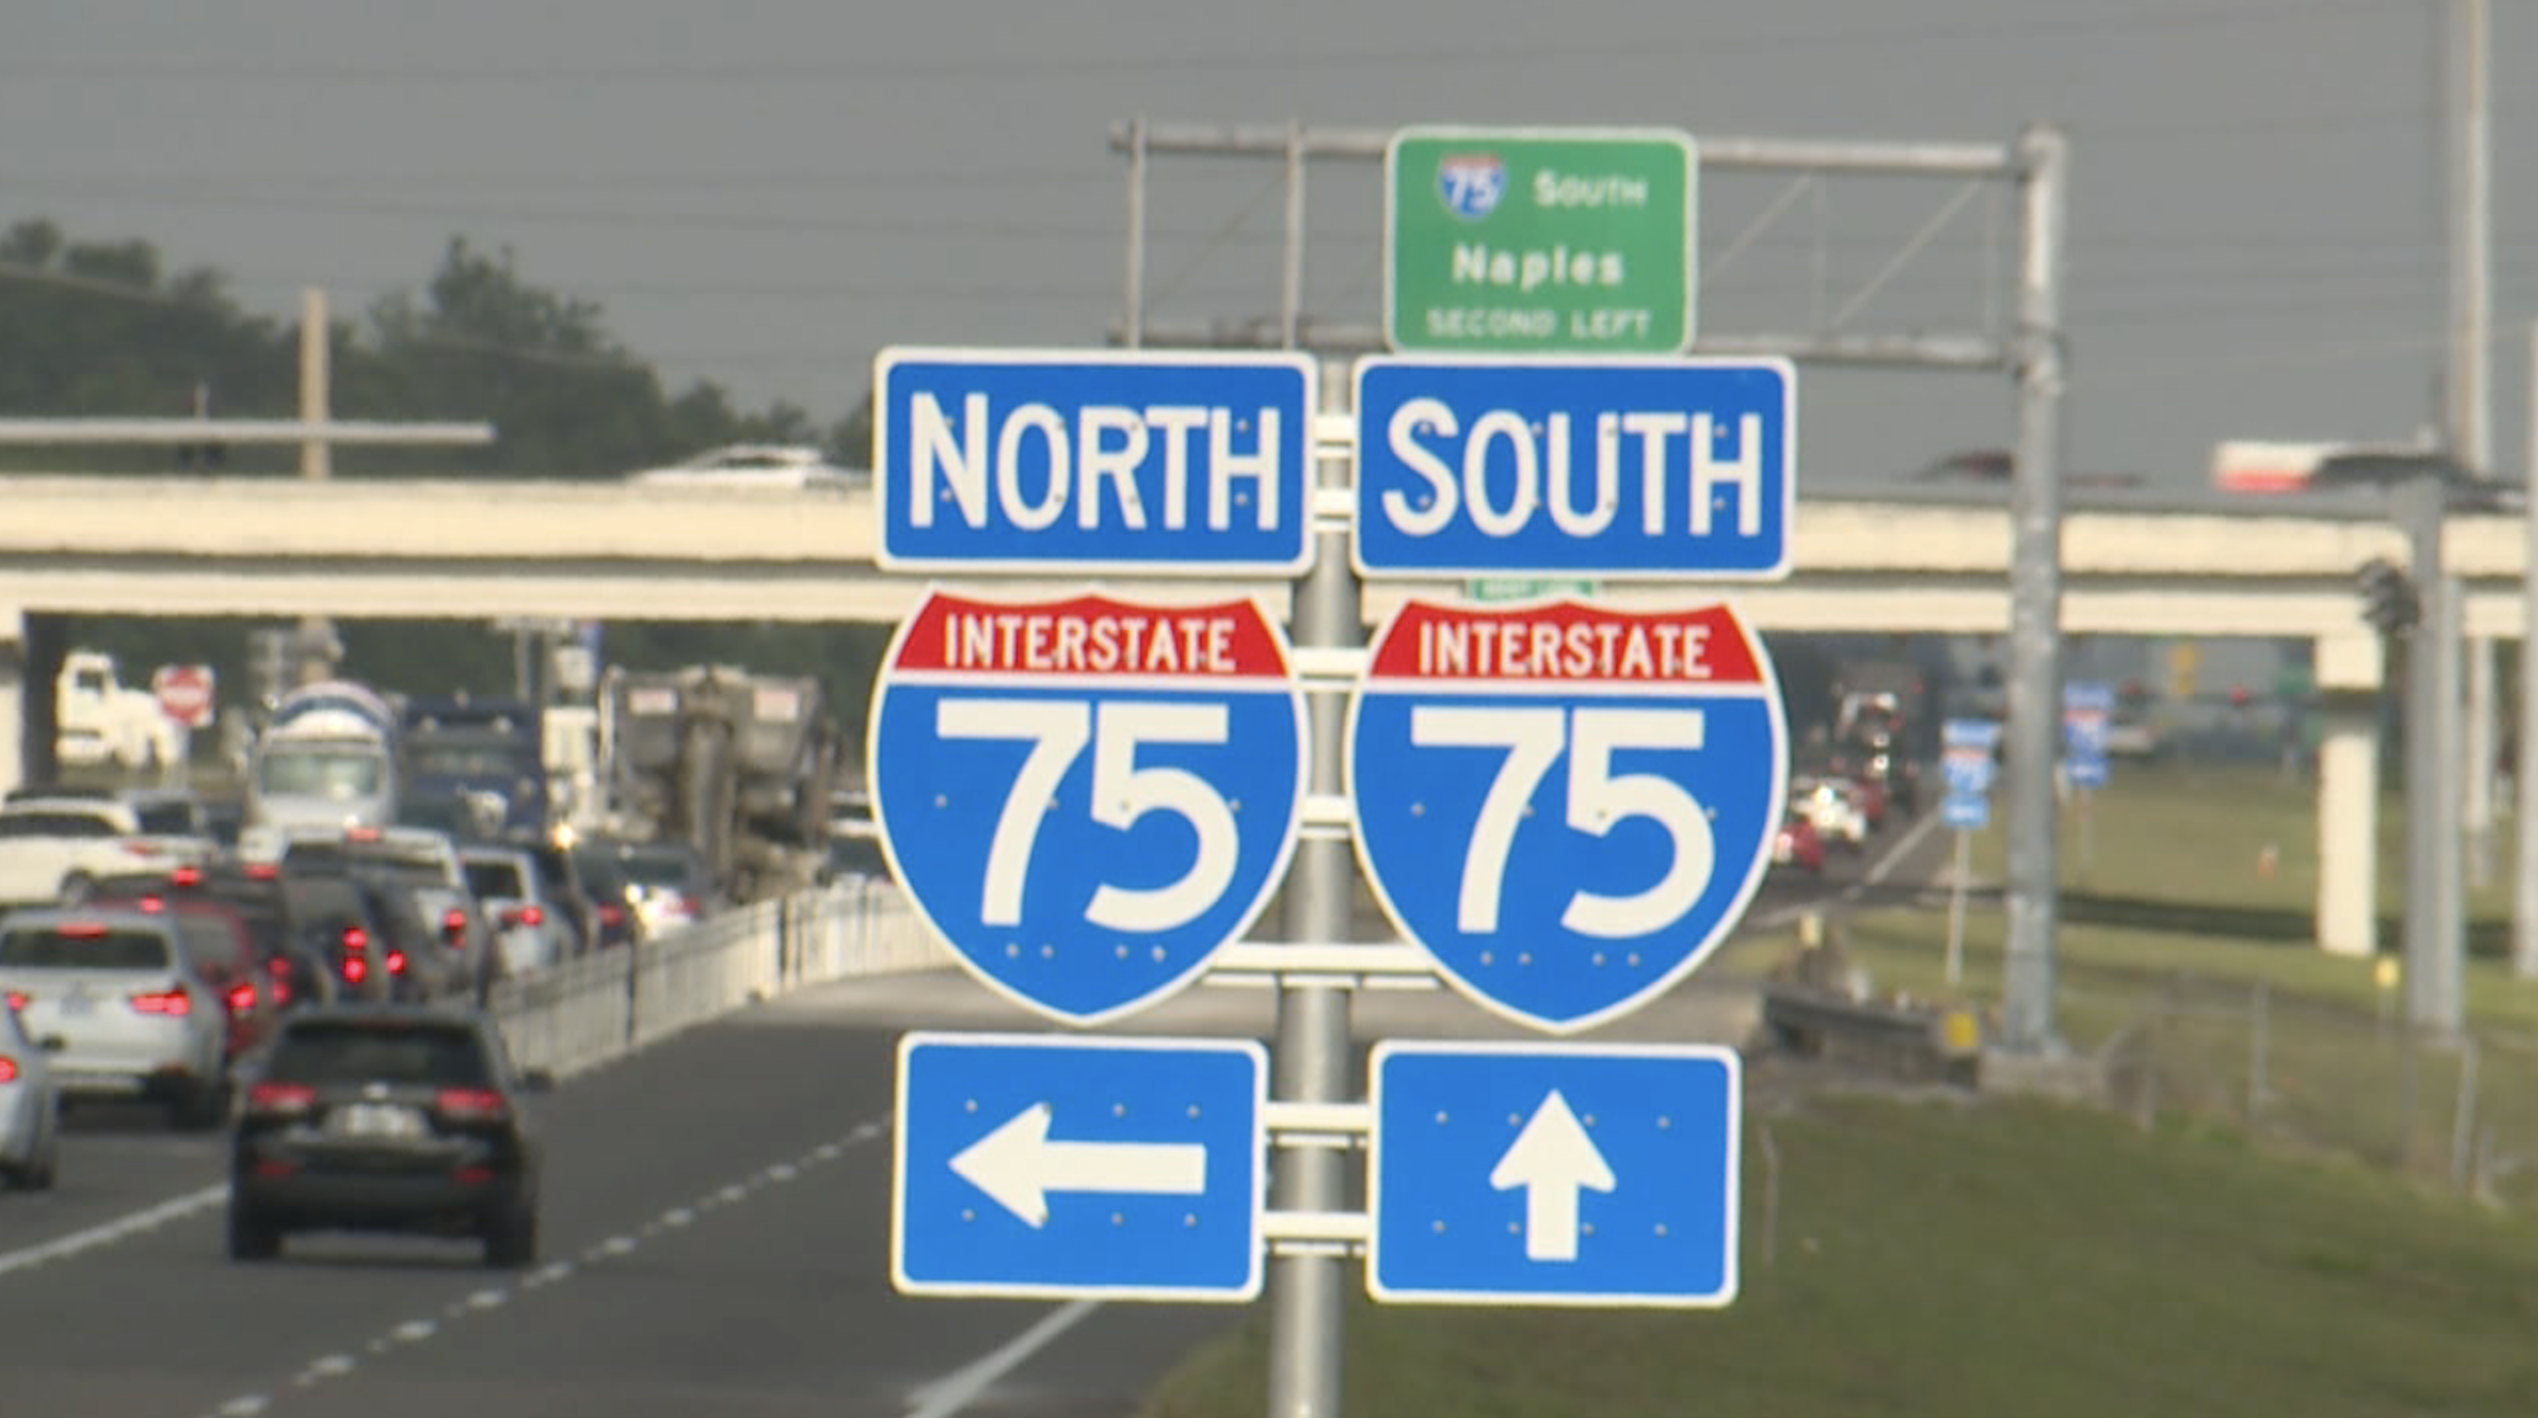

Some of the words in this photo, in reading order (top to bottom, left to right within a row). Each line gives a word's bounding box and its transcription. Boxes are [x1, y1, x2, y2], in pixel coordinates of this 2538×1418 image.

[1444, 167, 1499, 209] 75
[1533, 170, 1648, 207] SOUTH
[1453, 244, 1624, 293] Naples
[1426, 309, 1556, 338] SECOND
[1570, 309, 1650, 339] LEFT
[910, 393, 1280, 531] NORTH
[1382, 398, 1761, 537] SOUTH
[945, 614, 1236, 674] INTERSTATE
[1419, 622, 1711, 679] INTERSTATE
[937, 699, 1239, 932] 75
[1410, 706, 1715, 939] 75
